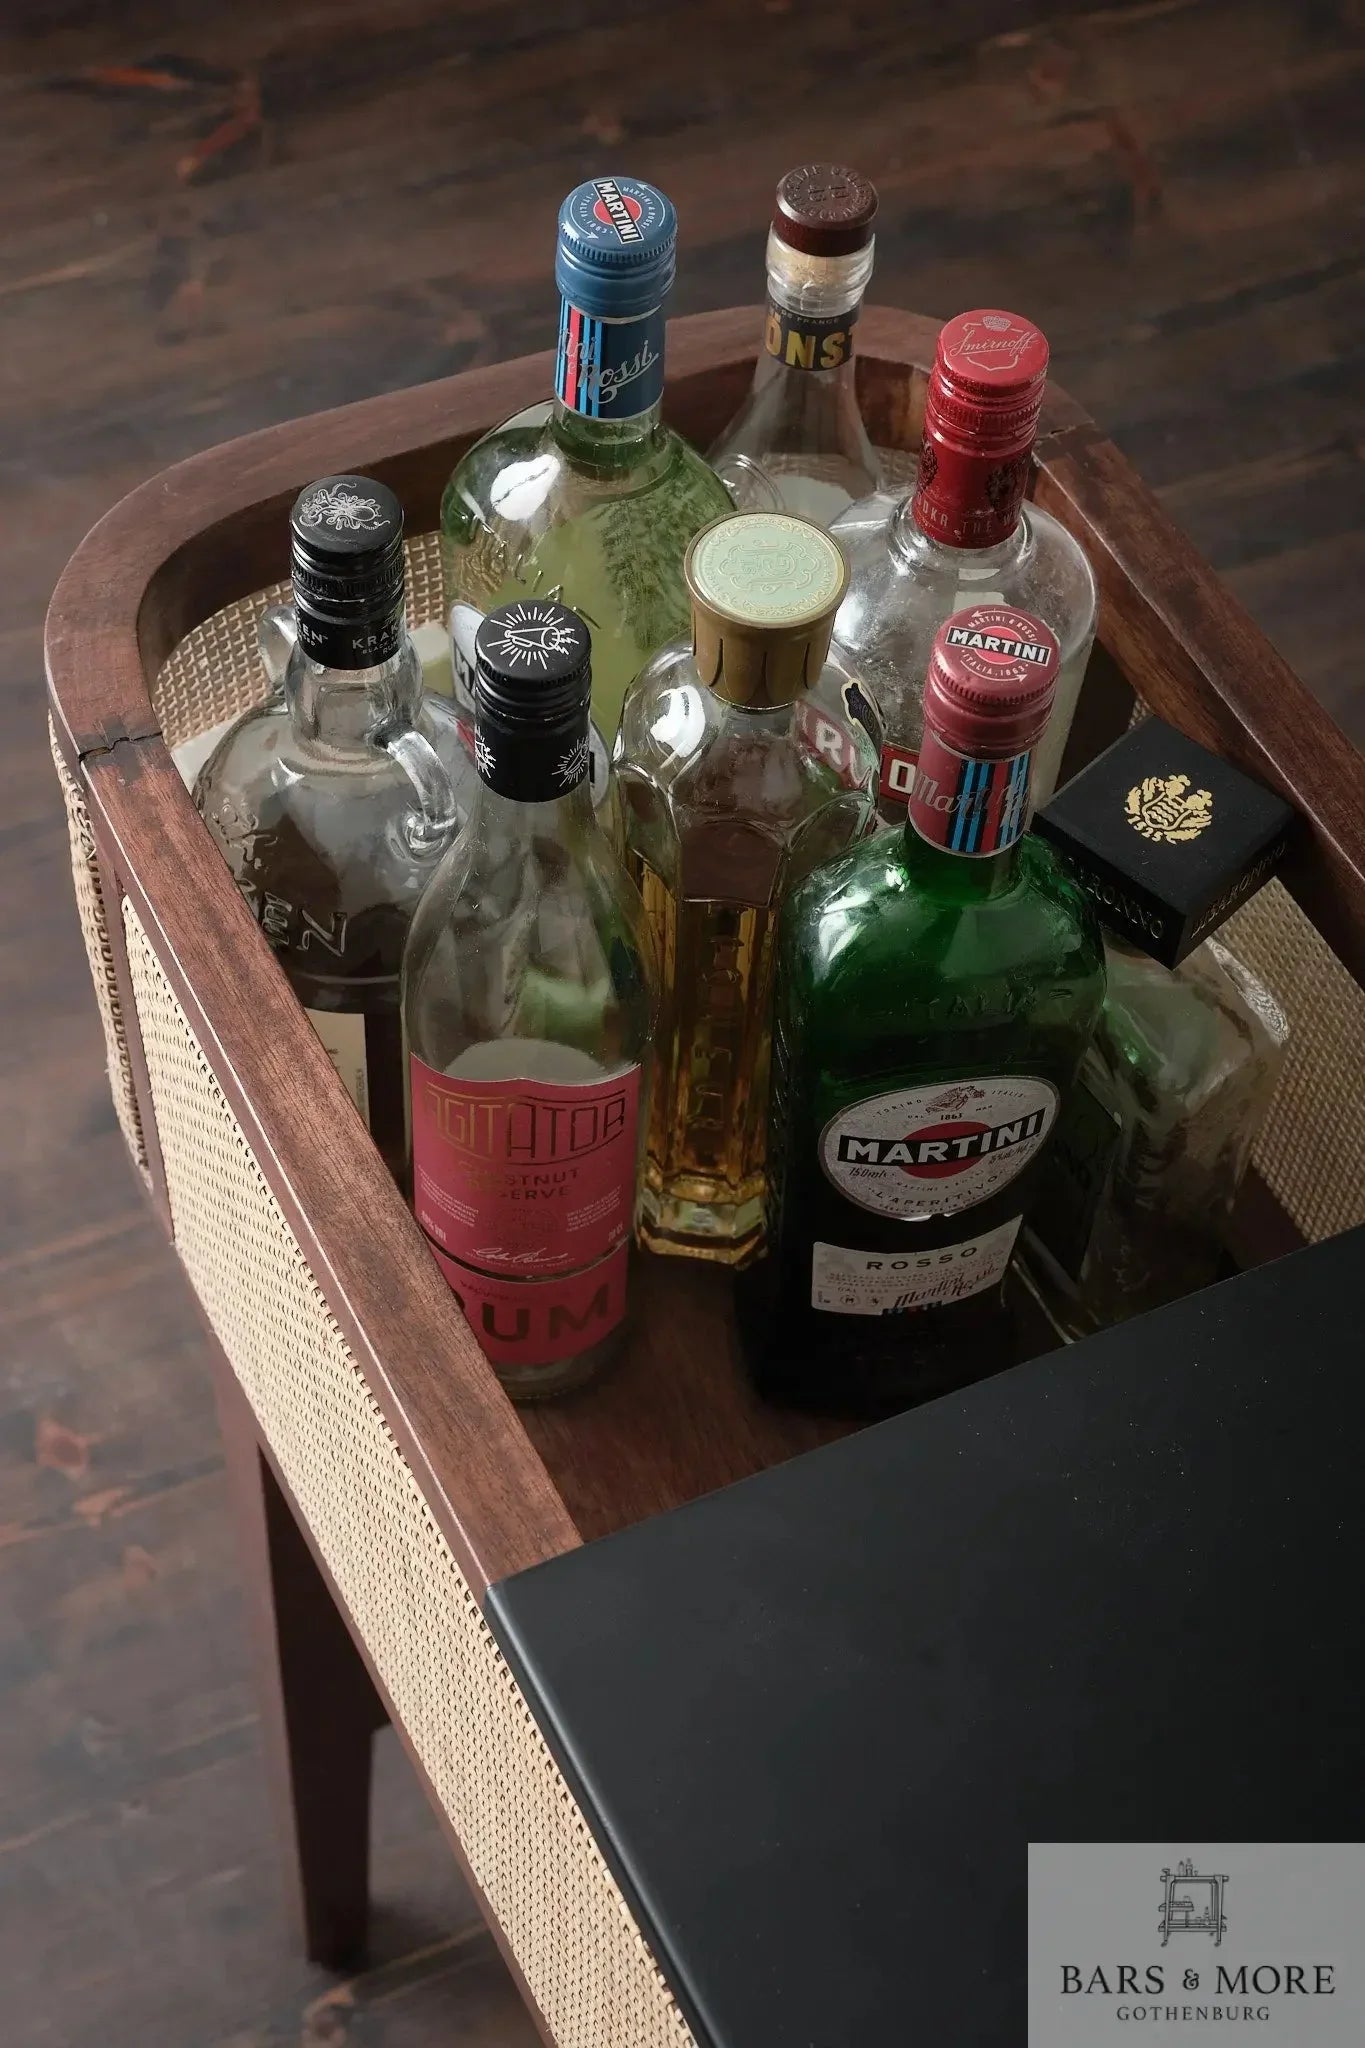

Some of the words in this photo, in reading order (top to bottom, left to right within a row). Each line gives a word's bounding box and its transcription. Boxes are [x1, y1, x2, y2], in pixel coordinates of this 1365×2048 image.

[597, 182, 640, 241] MARTINI
[797, 316, 839, 325] FRANCE
[950, 330, 1038, 356] Smirnoff
[577, 340, 660, 404] Rossi
[968, 615, 1006, 628] MARTINI
[1017, 622, 1038, 642] ROSSI
[951, 629, 1046, 663] MARTINI
[963, 653, 993, 675] ITALIA
[1127, 816, 1164, 842] 1525
[847, 1114, 1039, 1164] MARTINI
[866, 1246, 978, 1271] ROSSO
